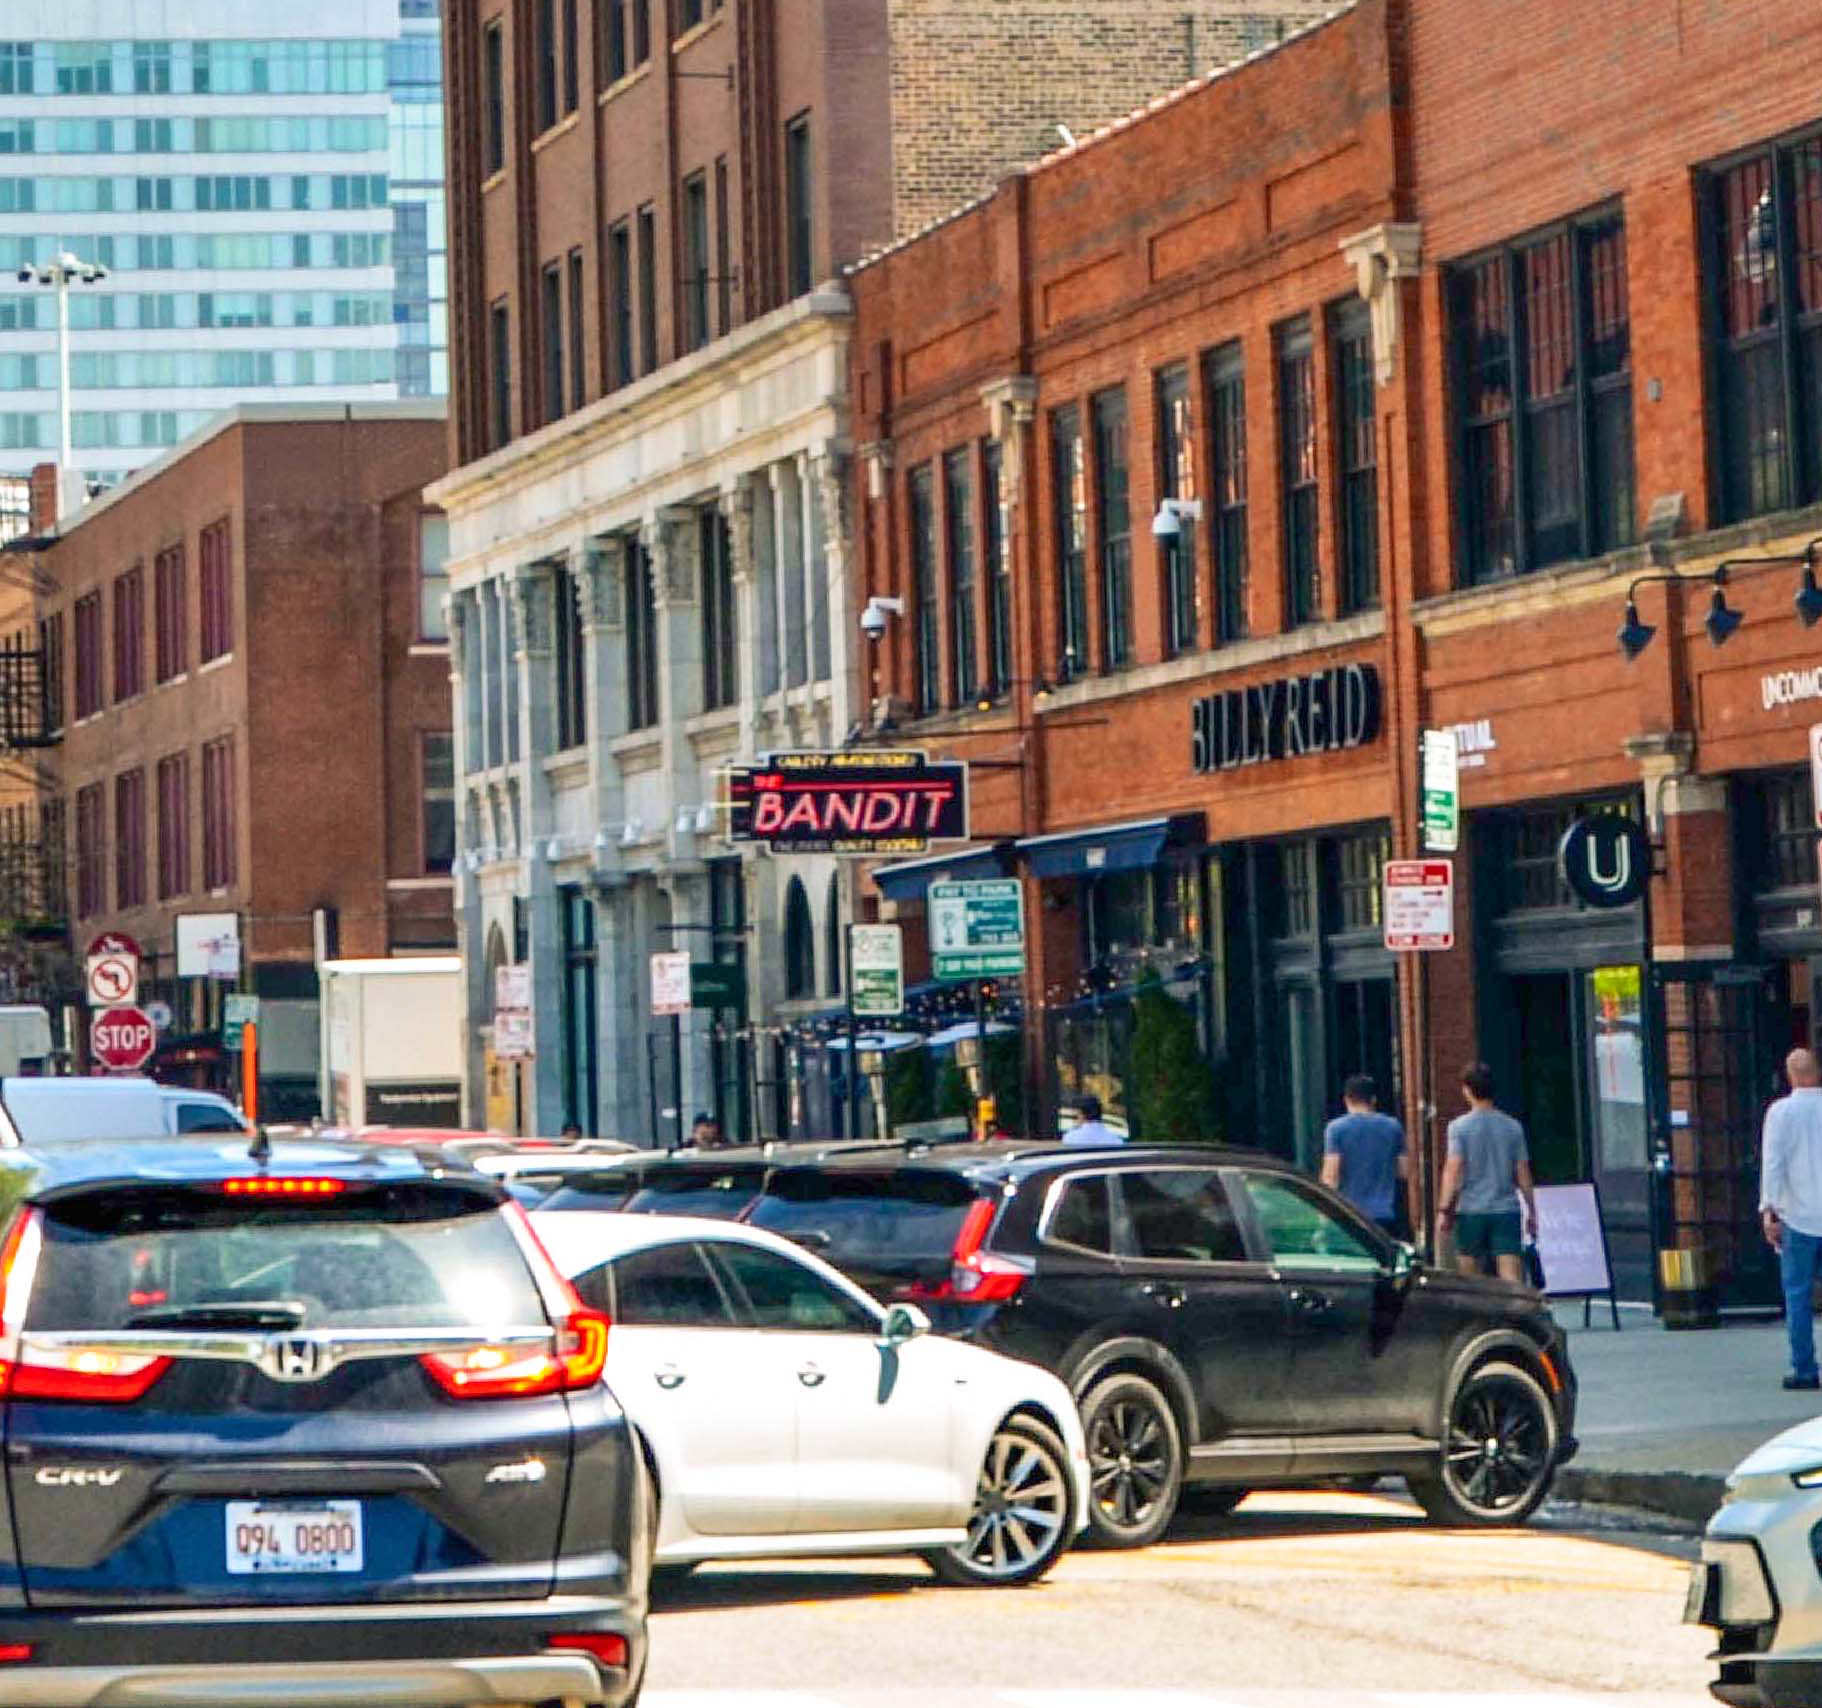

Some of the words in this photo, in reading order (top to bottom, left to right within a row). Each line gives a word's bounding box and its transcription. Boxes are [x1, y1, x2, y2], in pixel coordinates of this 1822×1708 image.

[1191, 682, 1277, 776] BILLY
[1284, 663, 1374, 759] REID
[753, 791, 954, 832] BANDIT
[96, 1025, 149, 1050] STOP
[35, 1467, 122, 1486] CR-V
